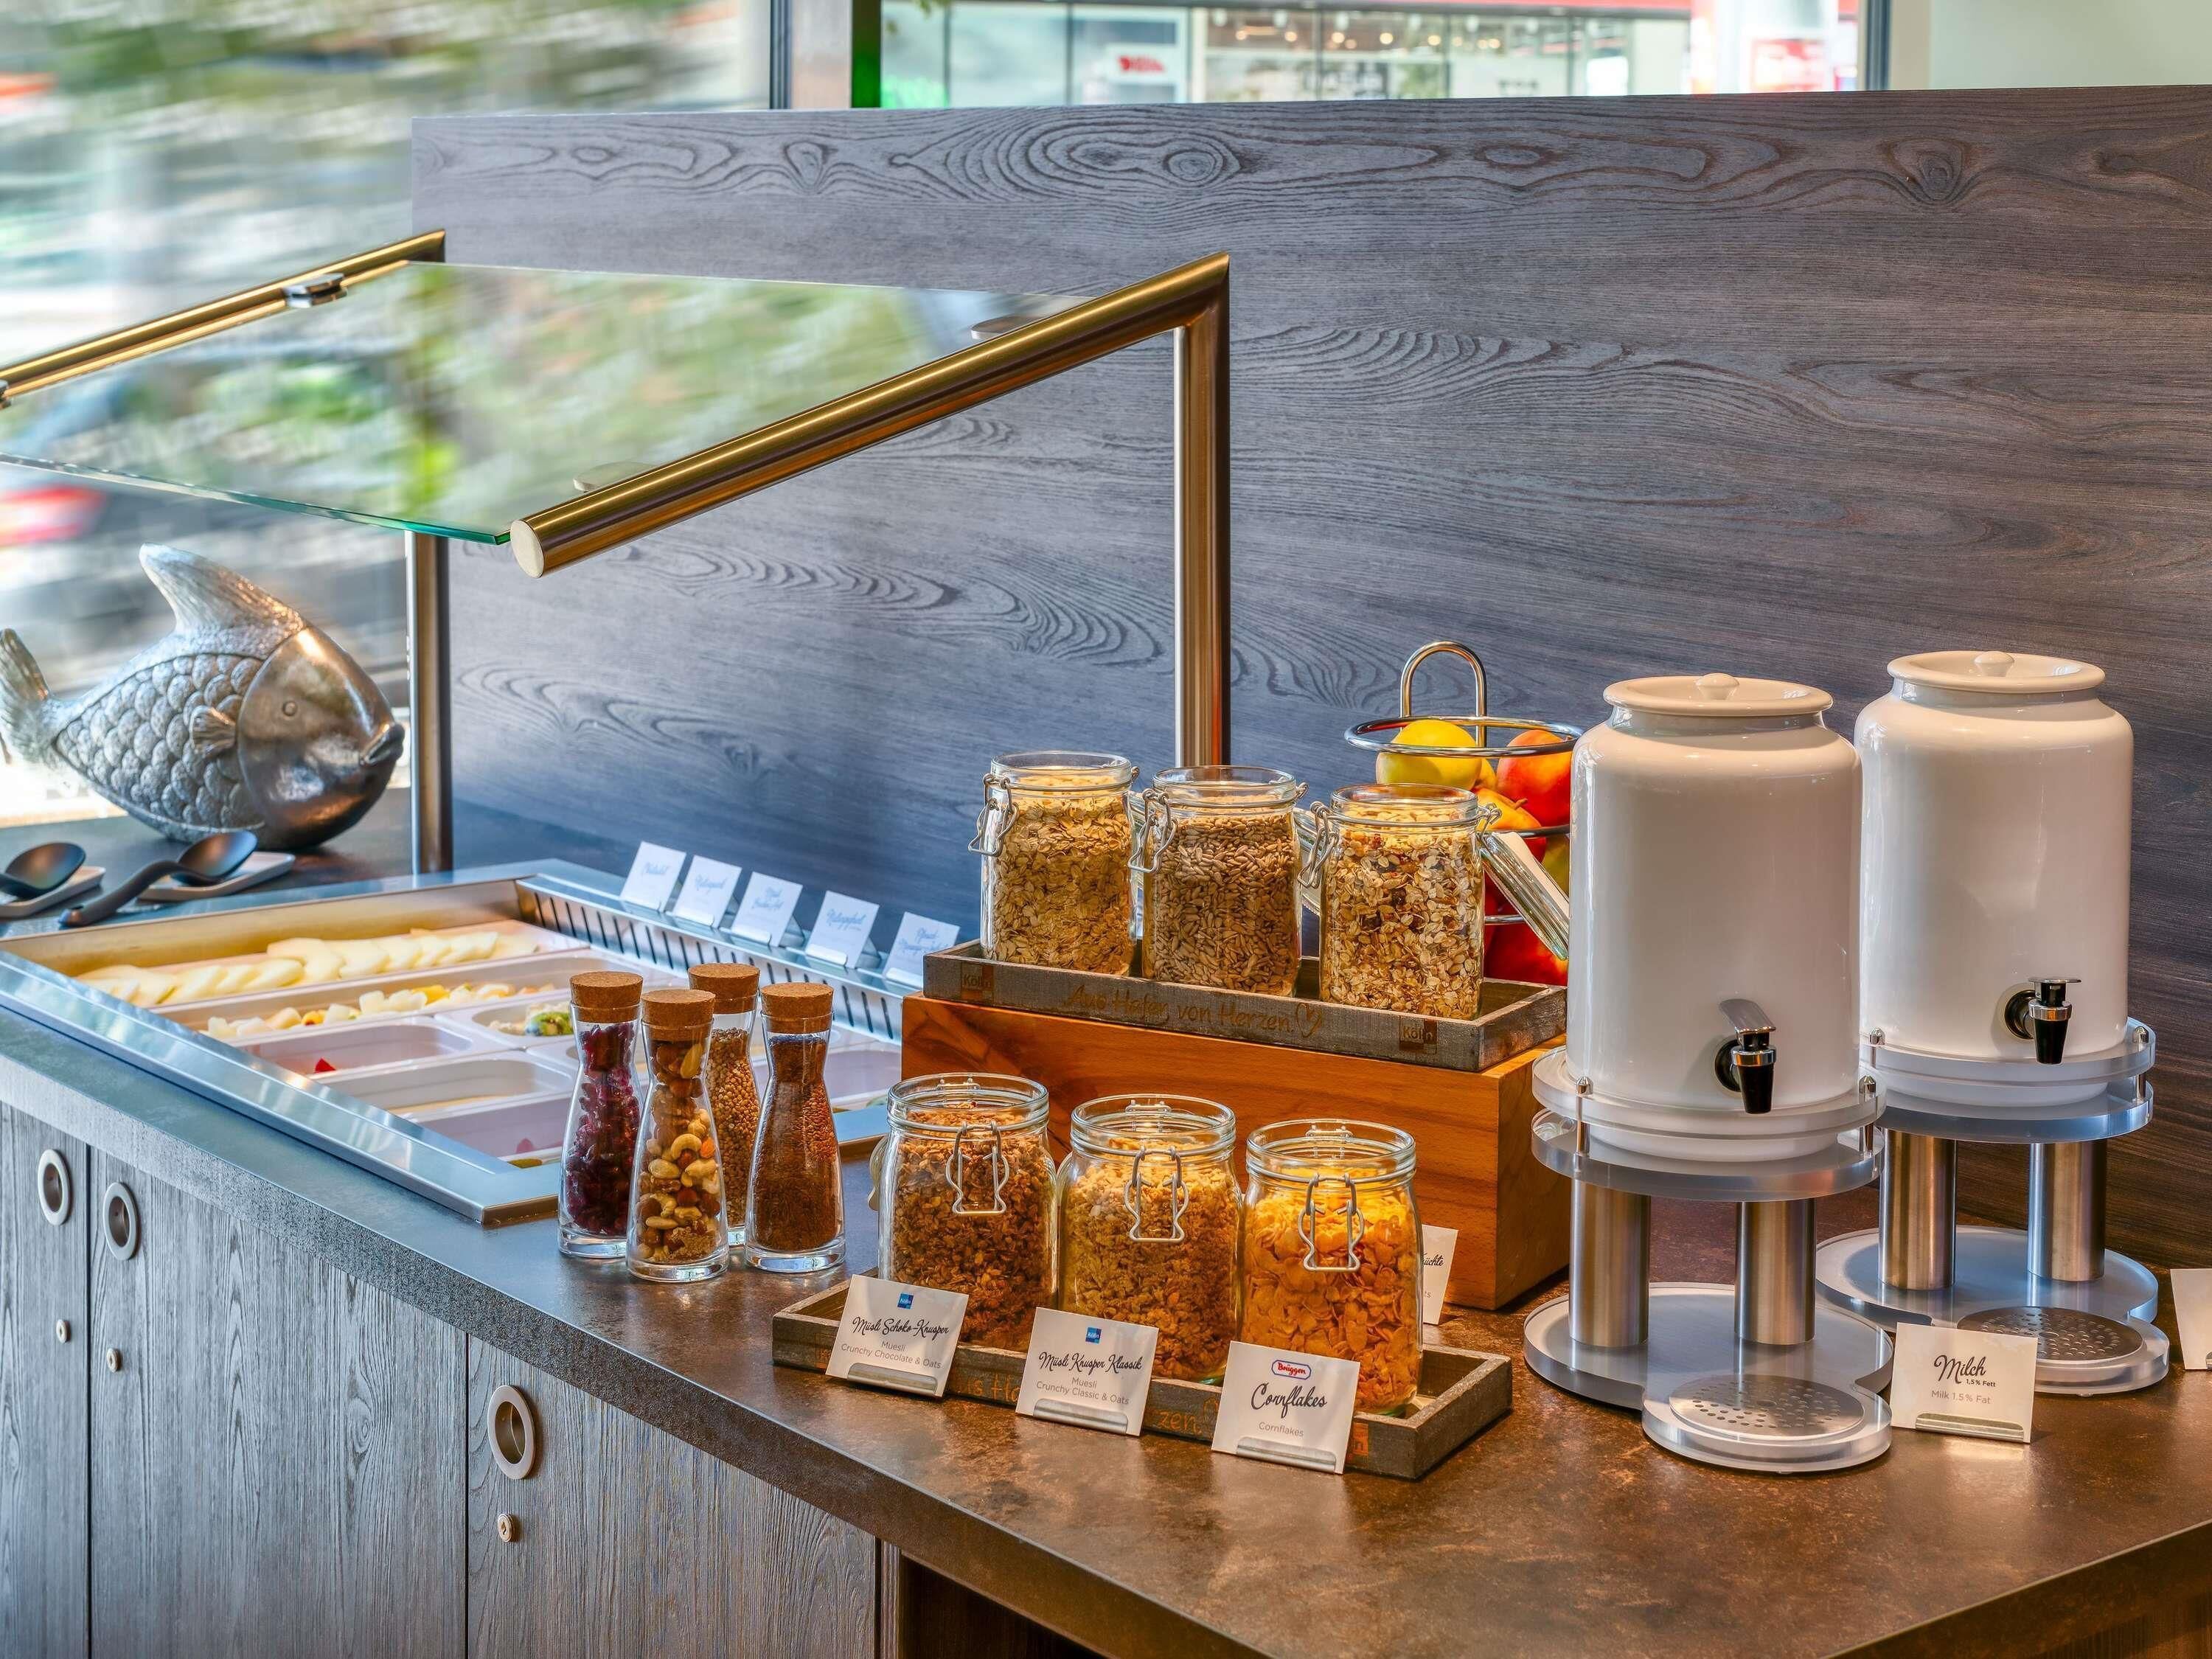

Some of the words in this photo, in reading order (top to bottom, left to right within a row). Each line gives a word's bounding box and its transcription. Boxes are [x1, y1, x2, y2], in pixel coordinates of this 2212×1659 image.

[1177, 1004, 1212, 1022] von
[852, 1316, 881, 1336] Müsli
[882, 1318, 950, 1341] Schoko-Knusper
[841, 1343, 872, 1357] Crunchy
[874, 1349, 914, 1364] Chocolate
[914, 1356, 921, 1365] &
[922, 1357, 942, 1369] Oats
[881, 1340, 906, 1352] Muesli
[1038, 1352, 1069, 1372] Müsli
[1068, 1352, 1106, 1376] Knusper
[1105, 1354, 1144, 1374] Klassik
[1276, 1362, 1307, 1377] Brüggen
[1933, 1354, 1987, 1384] Milch
[1036, 1381, 1070, 1395] Crunchy
[1071, 1387, 1099, 1399] Classic
[1101, 1393, 1107, 1401] &
[1110, 1394, 1130, 1405] Oats
[1071, 1377, 1098, 1388] Muesli
[1251, 1382, 1328, 1419] Cornflakes
[1931, 1390, 1950, 1399] Milk
[1975, 1395, 1992, 1404] Fat
[1259, 1422, 1304, 1438] Cornflakes
